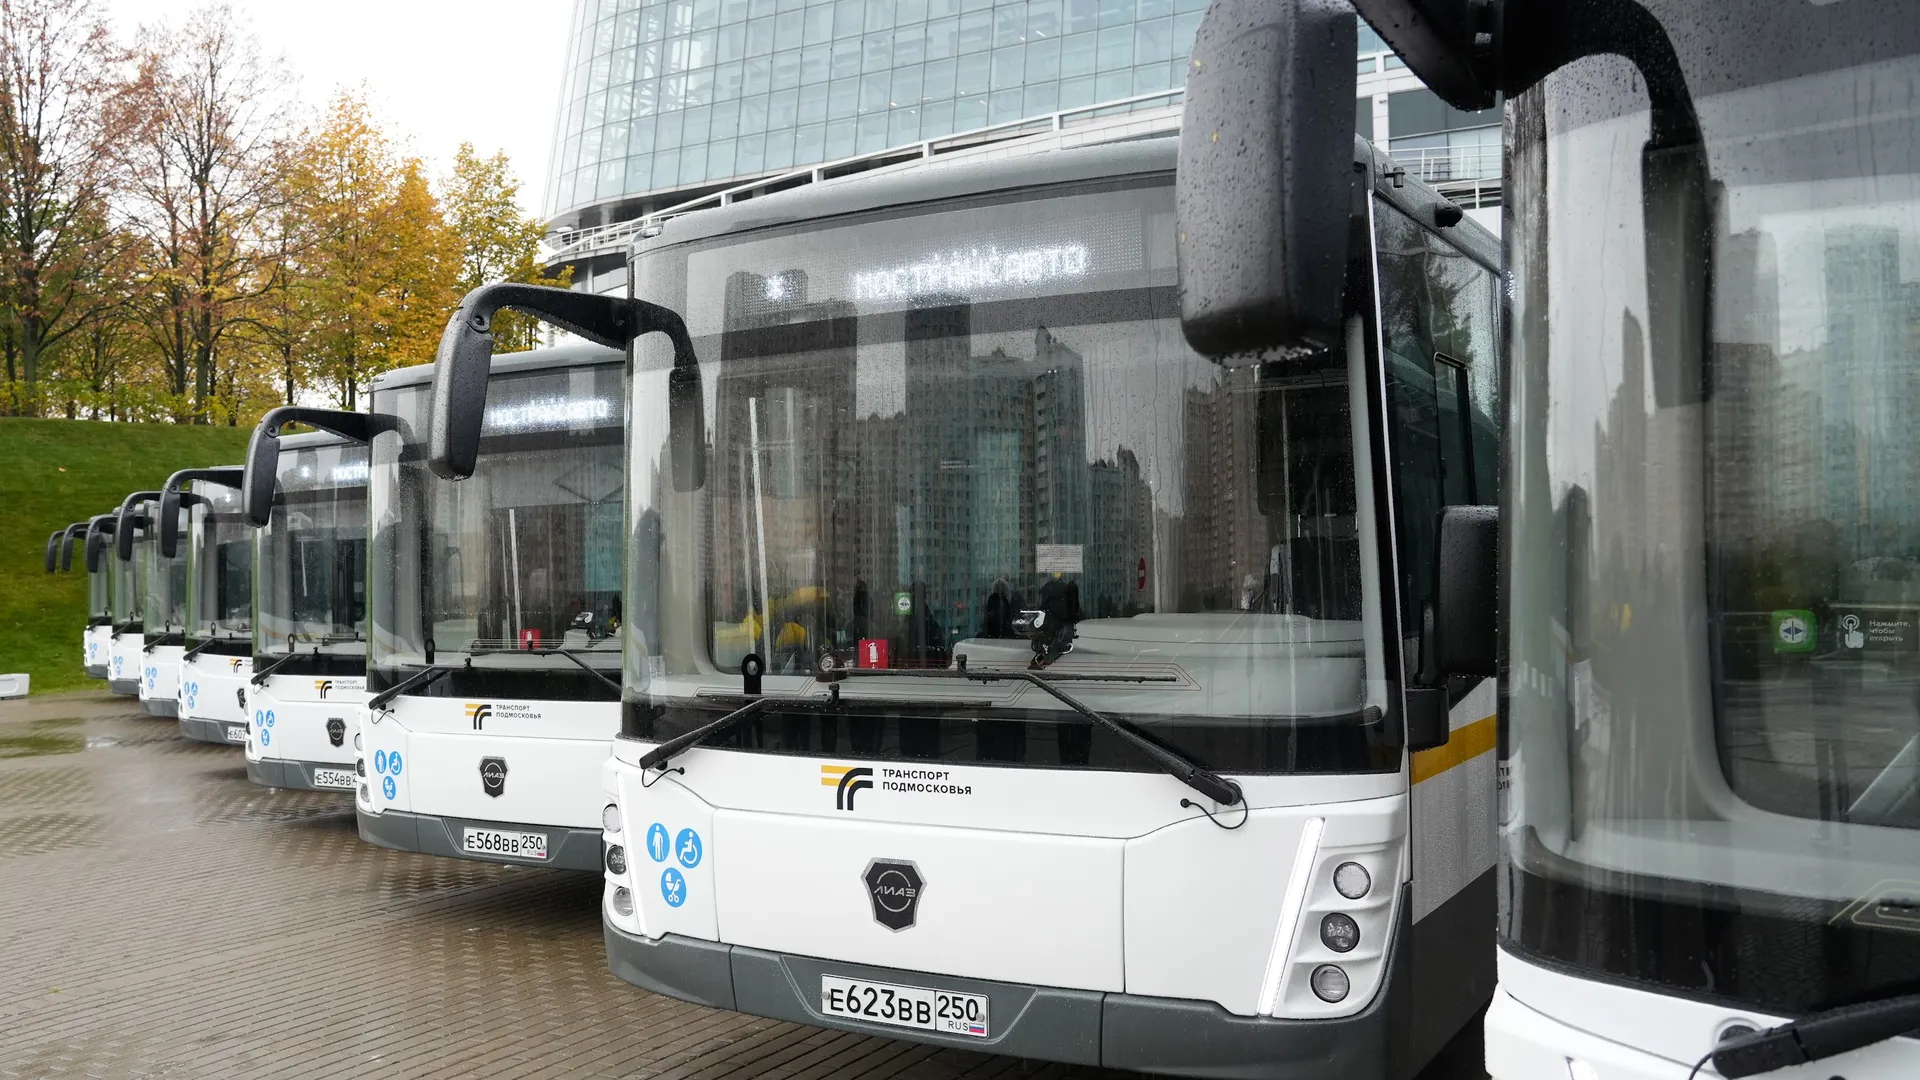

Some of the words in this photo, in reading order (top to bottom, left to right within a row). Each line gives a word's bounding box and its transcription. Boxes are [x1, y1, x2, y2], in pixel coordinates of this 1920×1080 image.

[1869, 635, 1904, 643] открыть
[495, 704, 530, 712] ТРАНСПОРТ
[882, 768, 950, 781] ТРАНСПОРТ
[882, 781, 973, 795] ПОДМОСКОВЬЯ
[521, 835, 543, 850] 250
[937, 994, 980, 1022] 250
[947, 1020, 969, 1032] RUS
